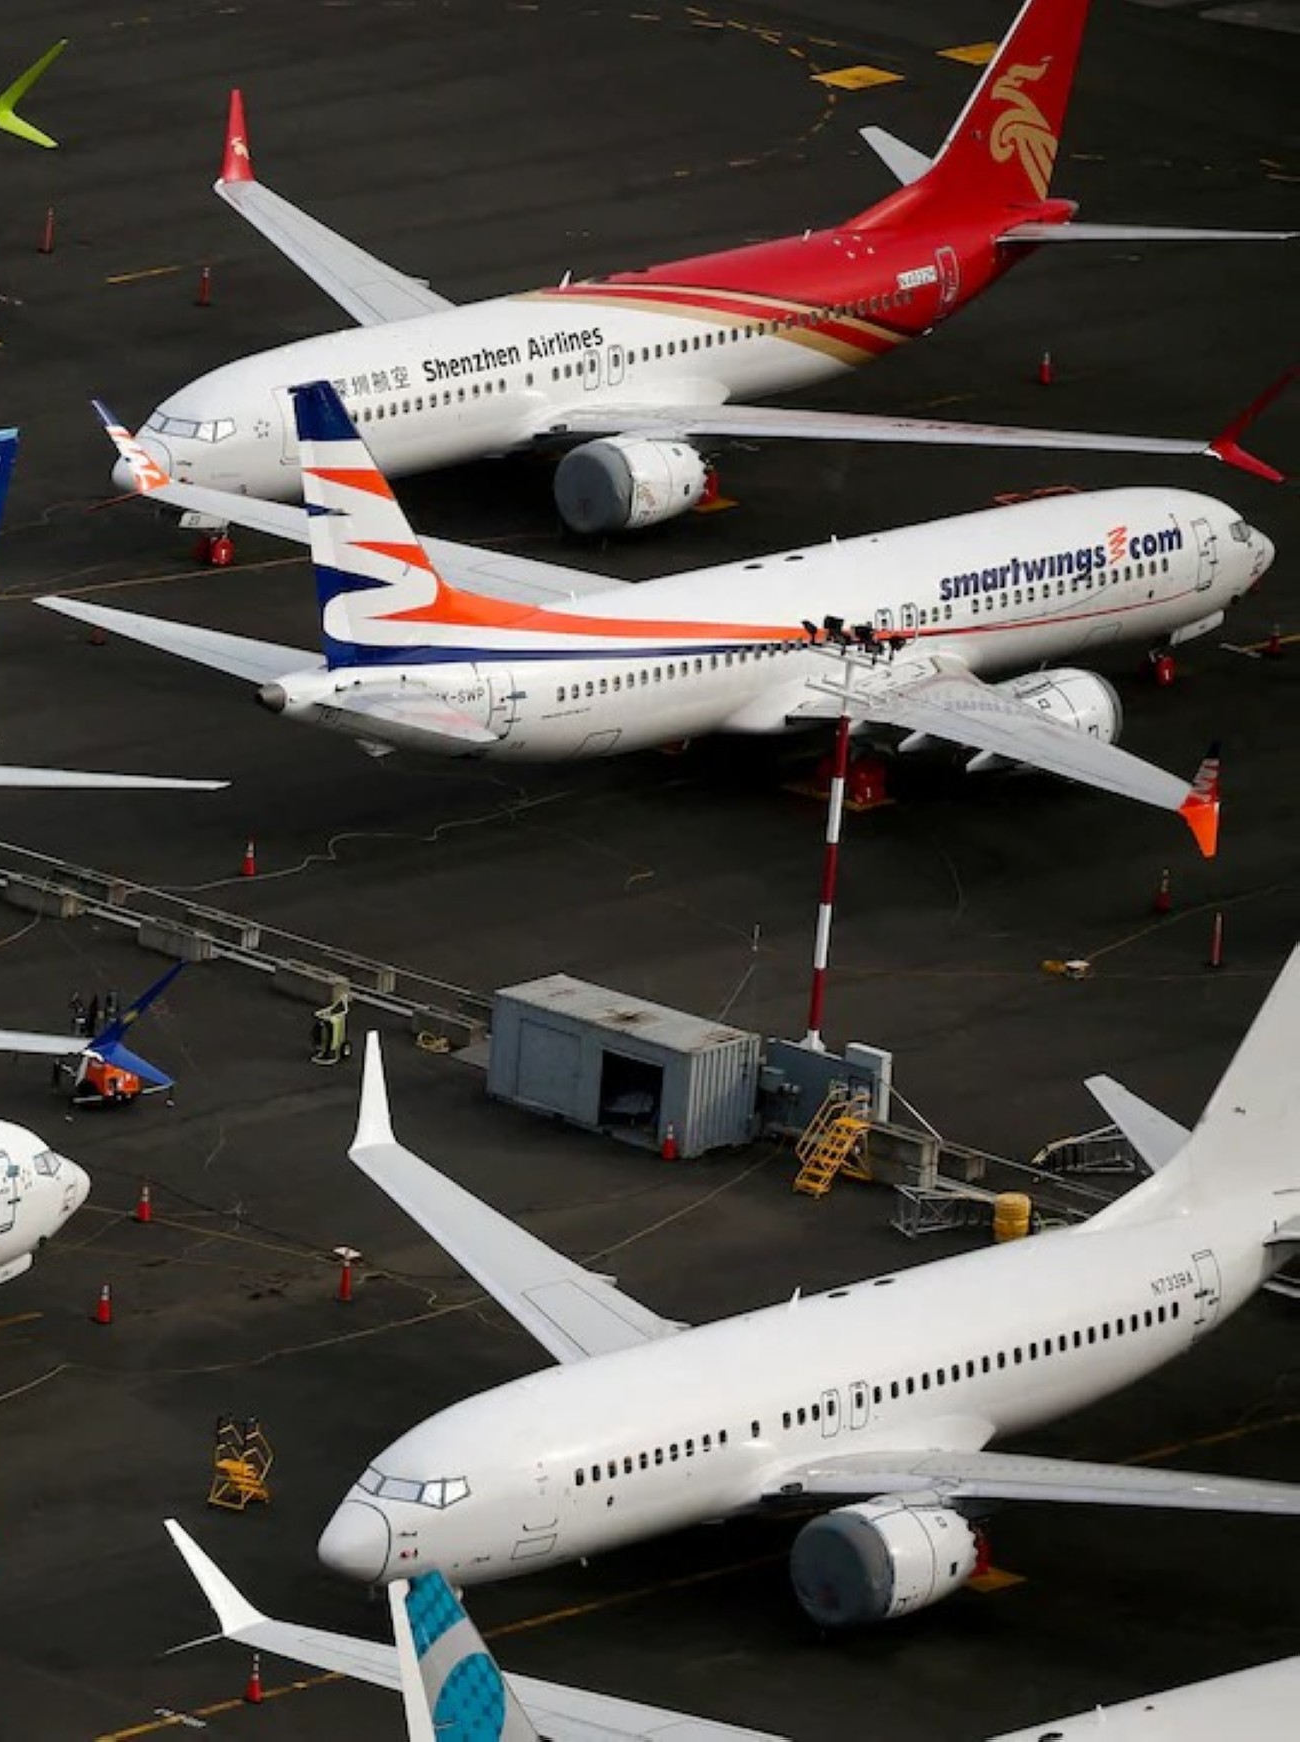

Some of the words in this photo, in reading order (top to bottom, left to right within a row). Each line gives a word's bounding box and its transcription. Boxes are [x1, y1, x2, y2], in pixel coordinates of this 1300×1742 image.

[421, 343, 521, 383] Shenzhen
[526, 326, 605, 362] Airlines
[938, 544, 1108, 602] smartwings
